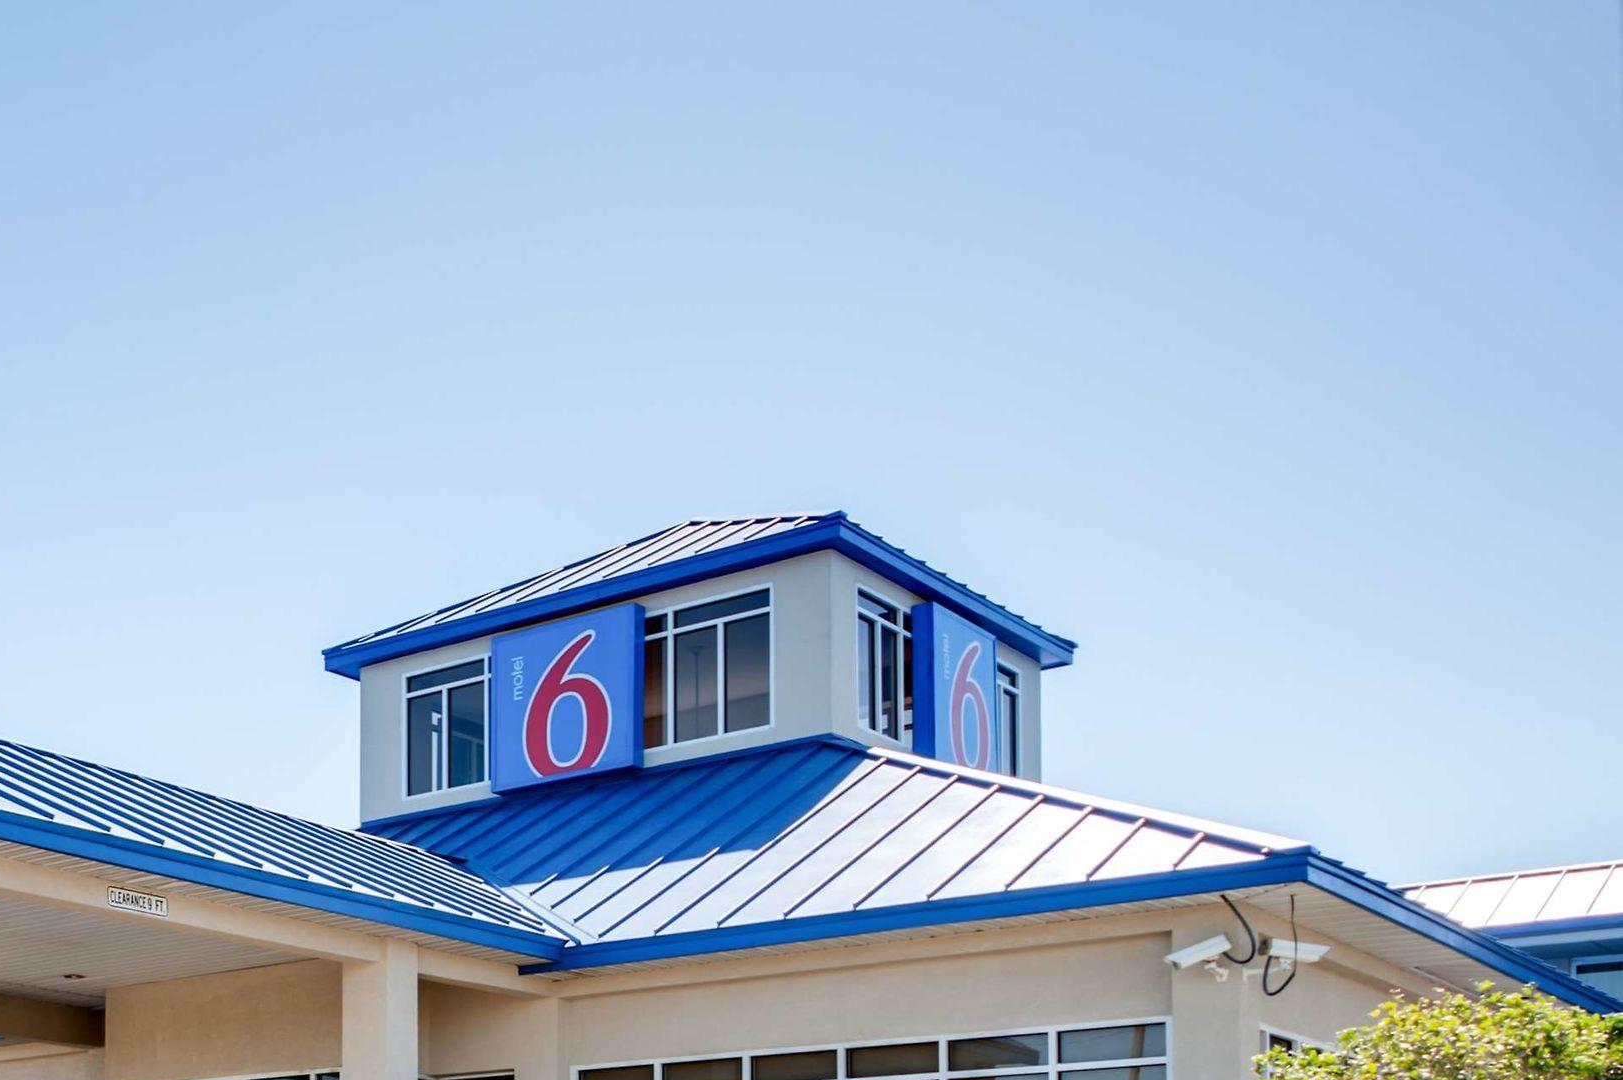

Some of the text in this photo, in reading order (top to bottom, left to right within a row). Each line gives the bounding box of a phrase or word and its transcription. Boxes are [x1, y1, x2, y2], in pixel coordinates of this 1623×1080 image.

[510, 629, 613, 778] motel 6
[949, 641, 991, 771] 6
